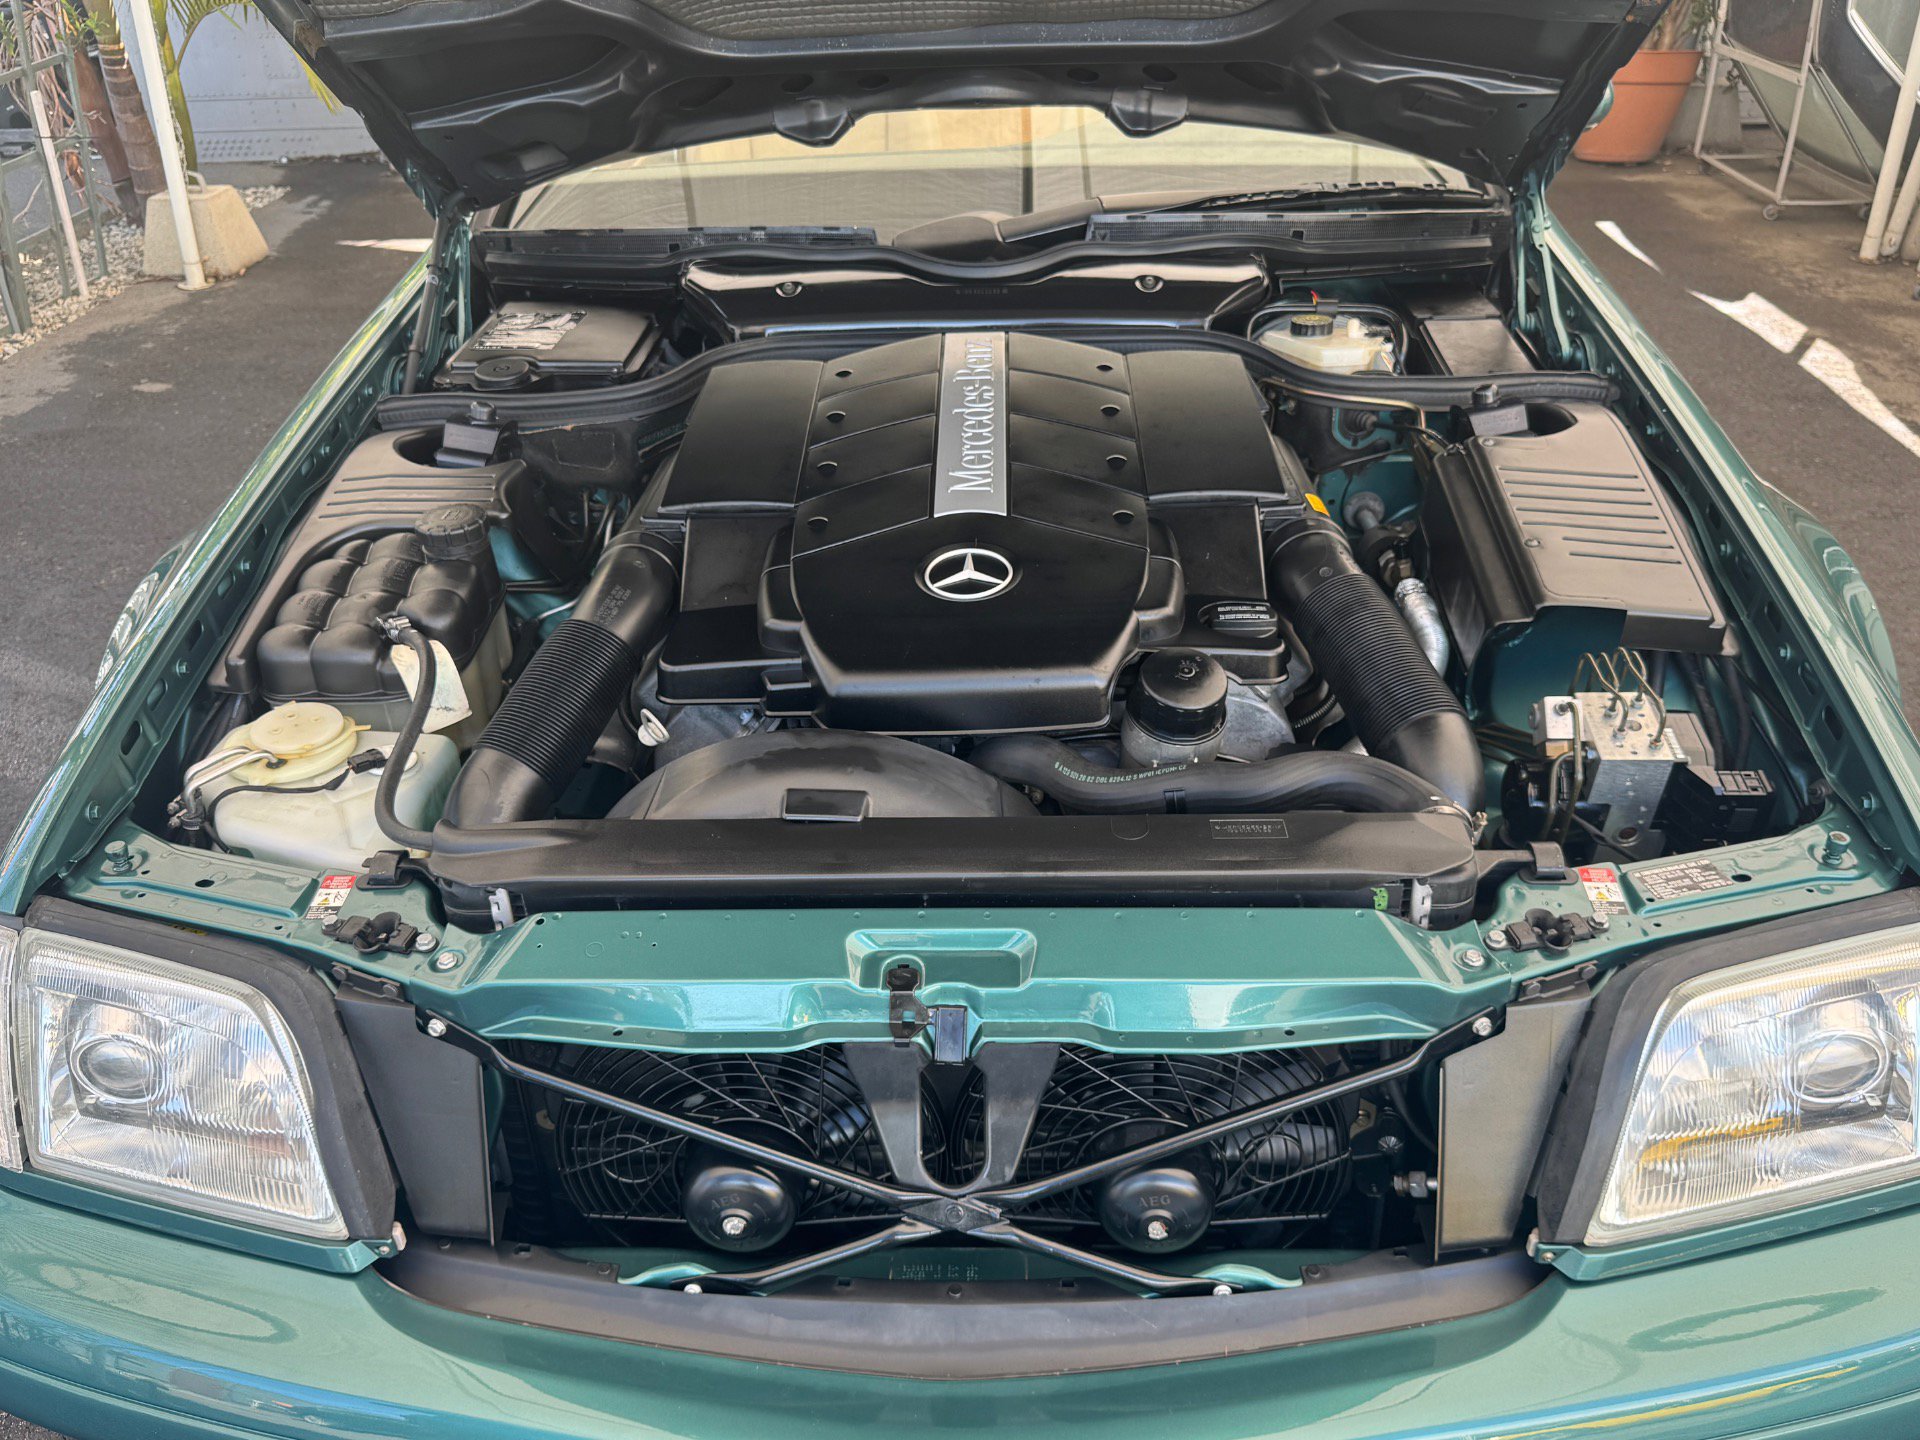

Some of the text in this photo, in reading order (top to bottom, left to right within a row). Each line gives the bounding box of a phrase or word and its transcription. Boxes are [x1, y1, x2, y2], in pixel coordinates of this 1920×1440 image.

[948, 338, 995, 493] Mercedes-Benz
[711, 1193, 741, 1210] AEG
[1139, 1194, 1171, 1208] AEG
